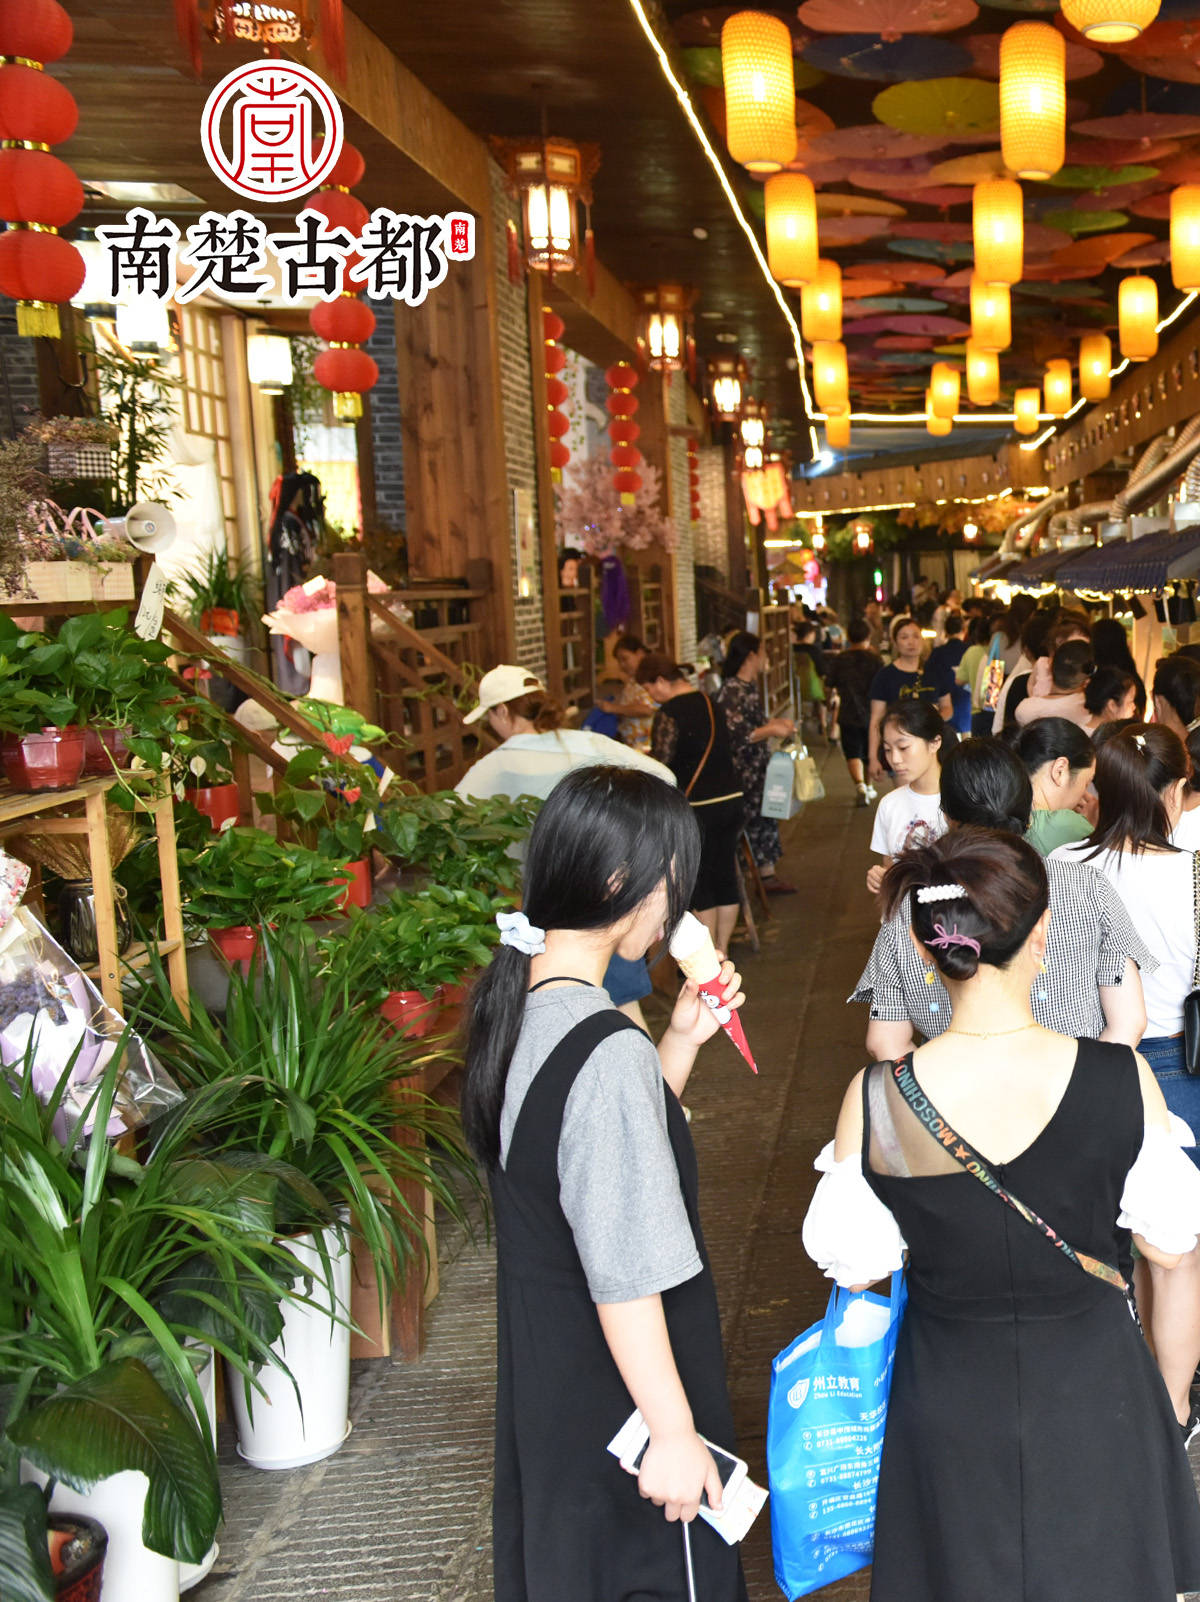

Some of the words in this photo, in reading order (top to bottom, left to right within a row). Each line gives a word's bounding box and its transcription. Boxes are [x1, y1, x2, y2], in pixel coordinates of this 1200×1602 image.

[894, 1063, 958, 1148] MOSCHINO
[813, 1375, 861, 1392] 州立教育
